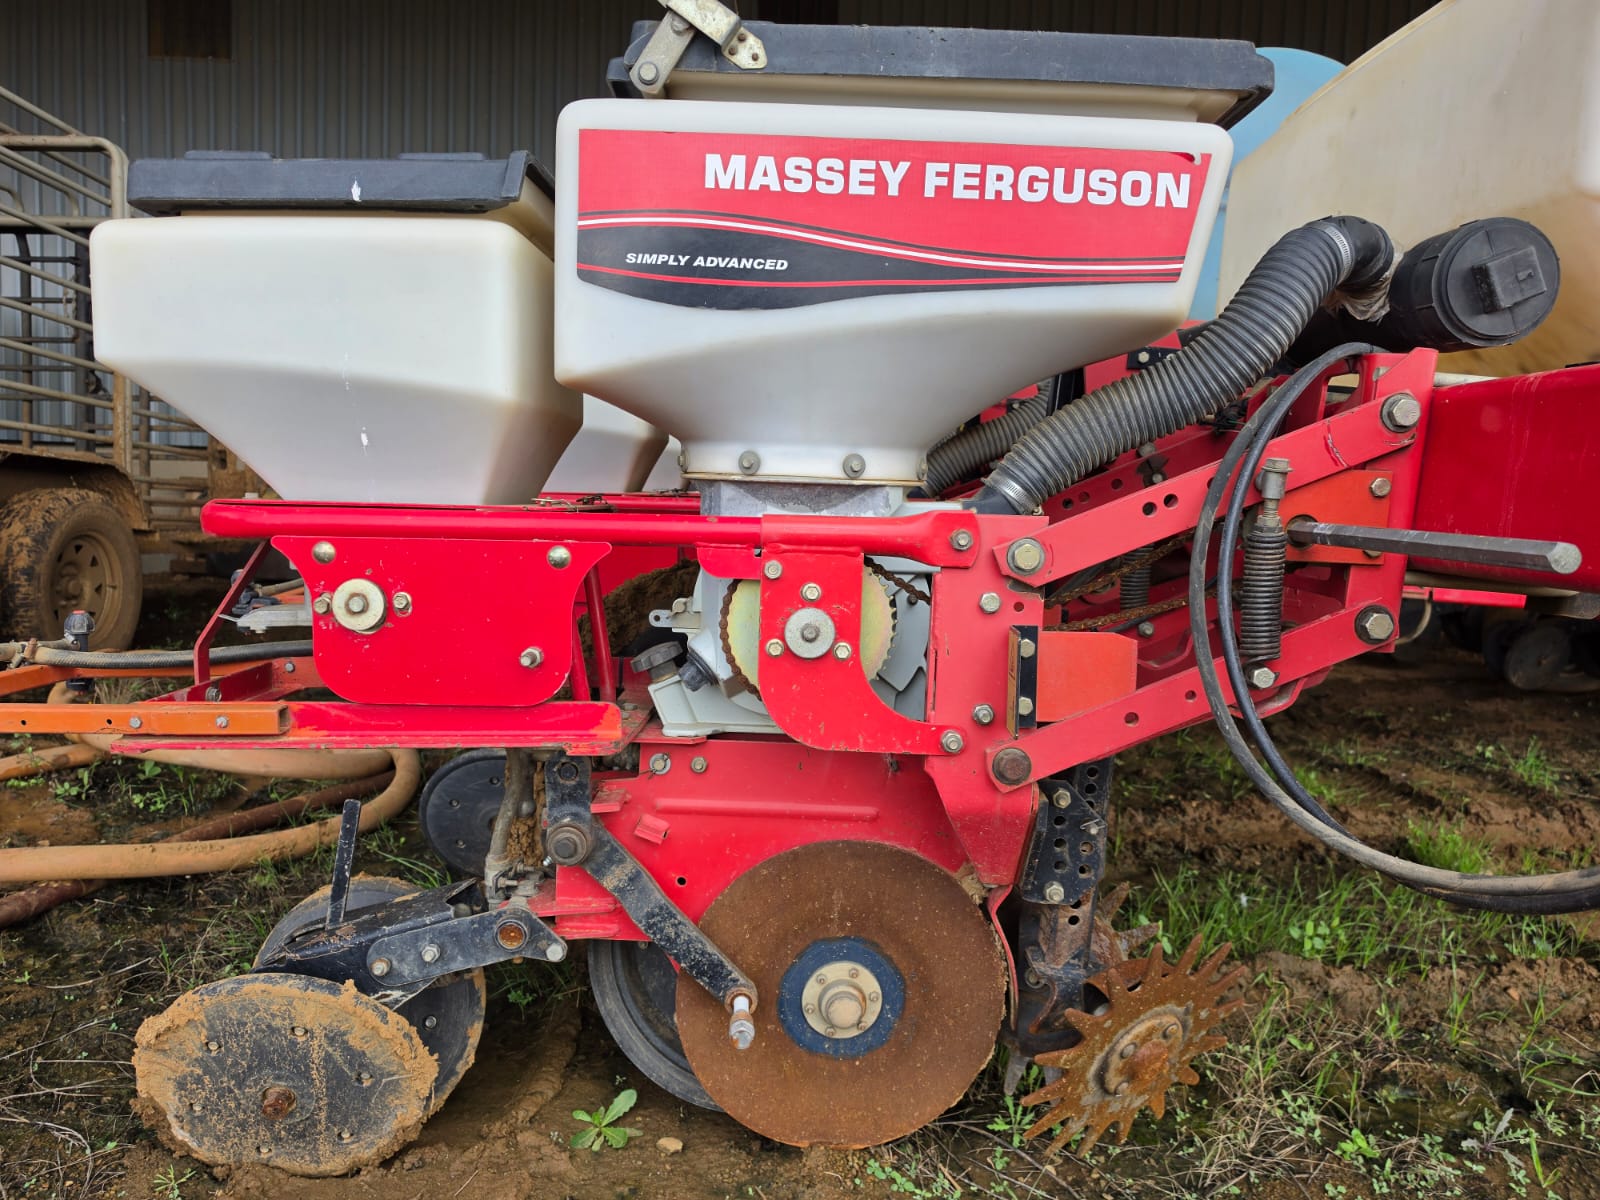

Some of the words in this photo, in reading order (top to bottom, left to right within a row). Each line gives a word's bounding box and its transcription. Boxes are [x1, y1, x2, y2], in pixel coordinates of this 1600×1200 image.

[704, 153, 912, 198] MASSEY
[923, 161, 1192, 209] FERGUSON
[625, 253, 691, 266] SIMPLY
[692, 256, 789, 271] ADVANCED
